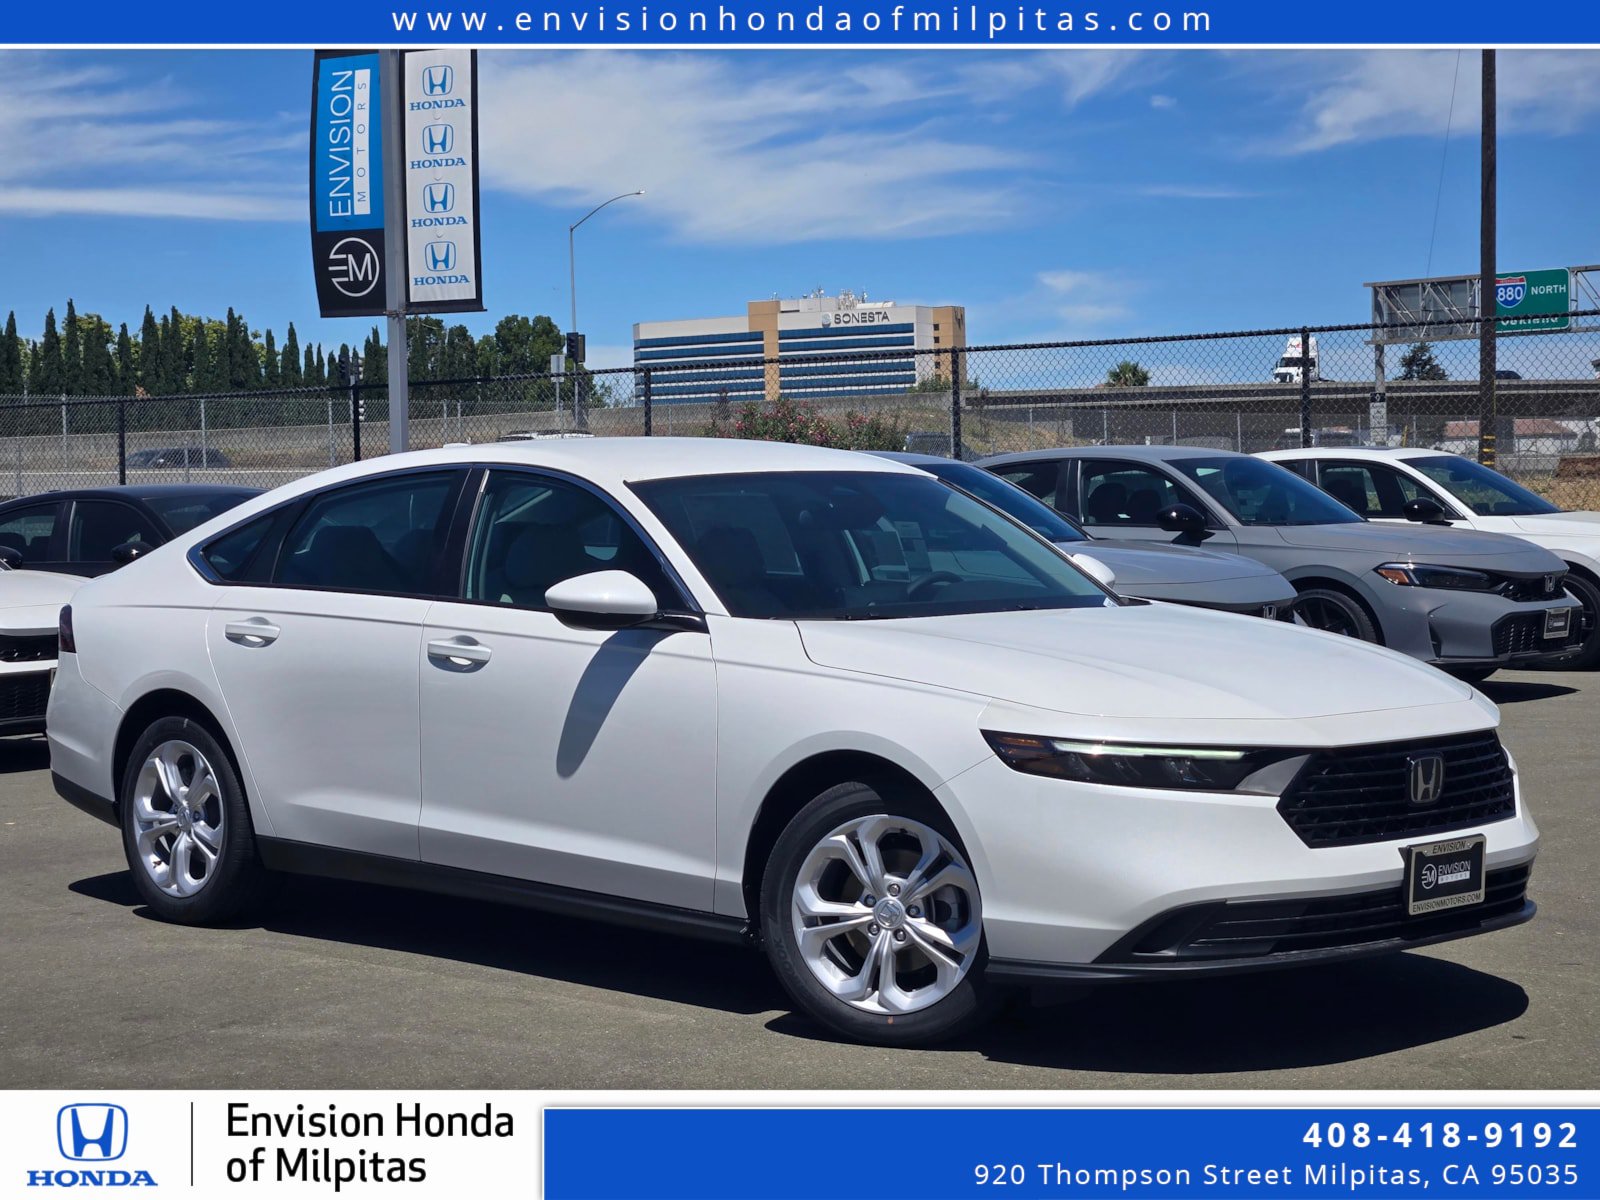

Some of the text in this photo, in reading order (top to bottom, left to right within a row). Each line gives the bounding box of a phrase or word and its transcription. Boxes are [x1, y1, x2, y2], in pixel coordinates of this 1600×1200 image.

[409, 98, 467, 111] HONDA
[329, 71, 353, 216] ENVISION
[356, 82, 366, 203] MOTORS
[410, 157, 467, 170] HONDA
[411, 215, 468, 228] HONDA
[413, 275, 470, 286] HONDA
[1497, 284, 1567, 301] 880 NORTH
[834, 311, 890, 325] SONESTA
[1433, 841, 1466, 854] ENVISION
[1438, 861, 1471, 876] ENVISION
[1412, 891, 1481, 913] ENVISIONMOTORS.COM
